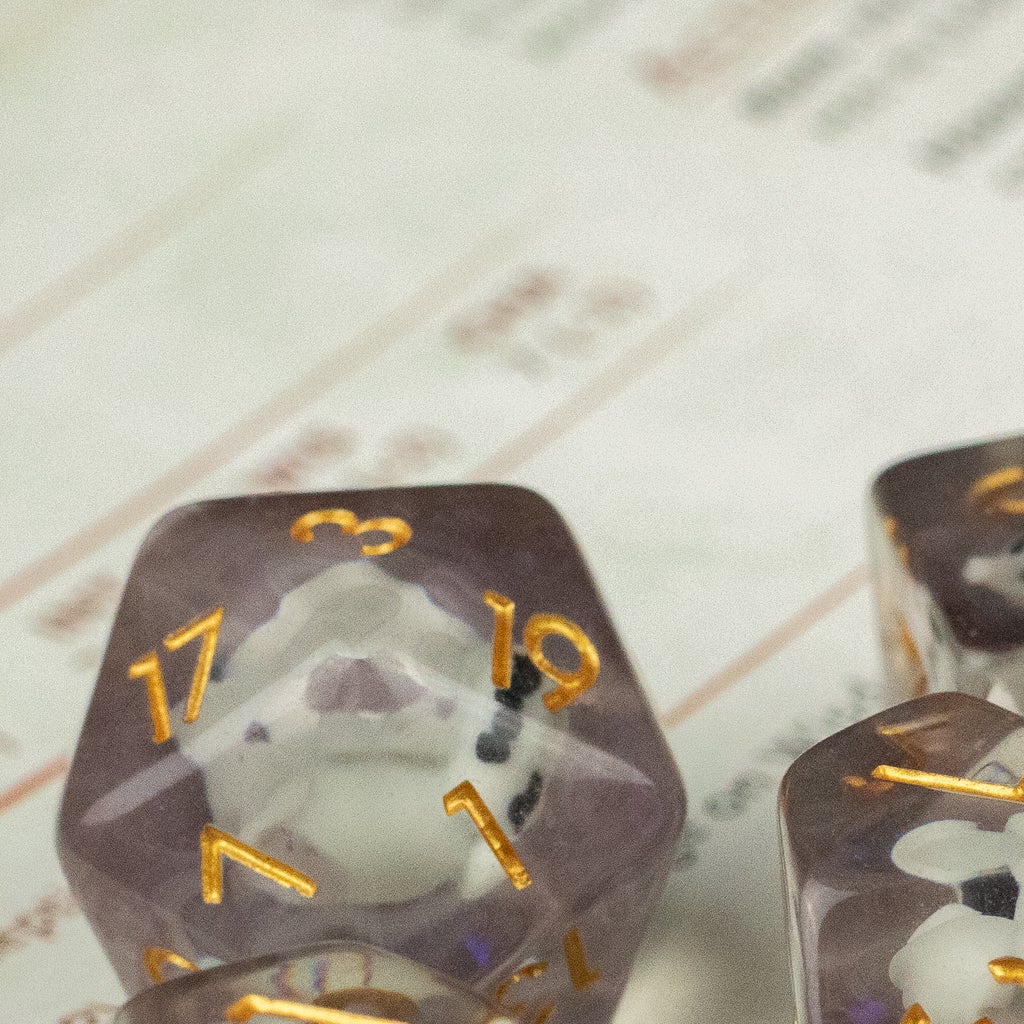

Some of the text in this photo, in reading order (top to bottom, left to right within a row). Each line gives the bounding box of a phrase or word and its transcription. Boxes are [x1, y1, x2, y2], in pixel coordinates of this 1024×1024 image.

[290, 508, 413, 557] 3
[128, 606, 225, 744] 17
[484, 590, 601, 714] 19
[442, 780, 533, 890] 1
